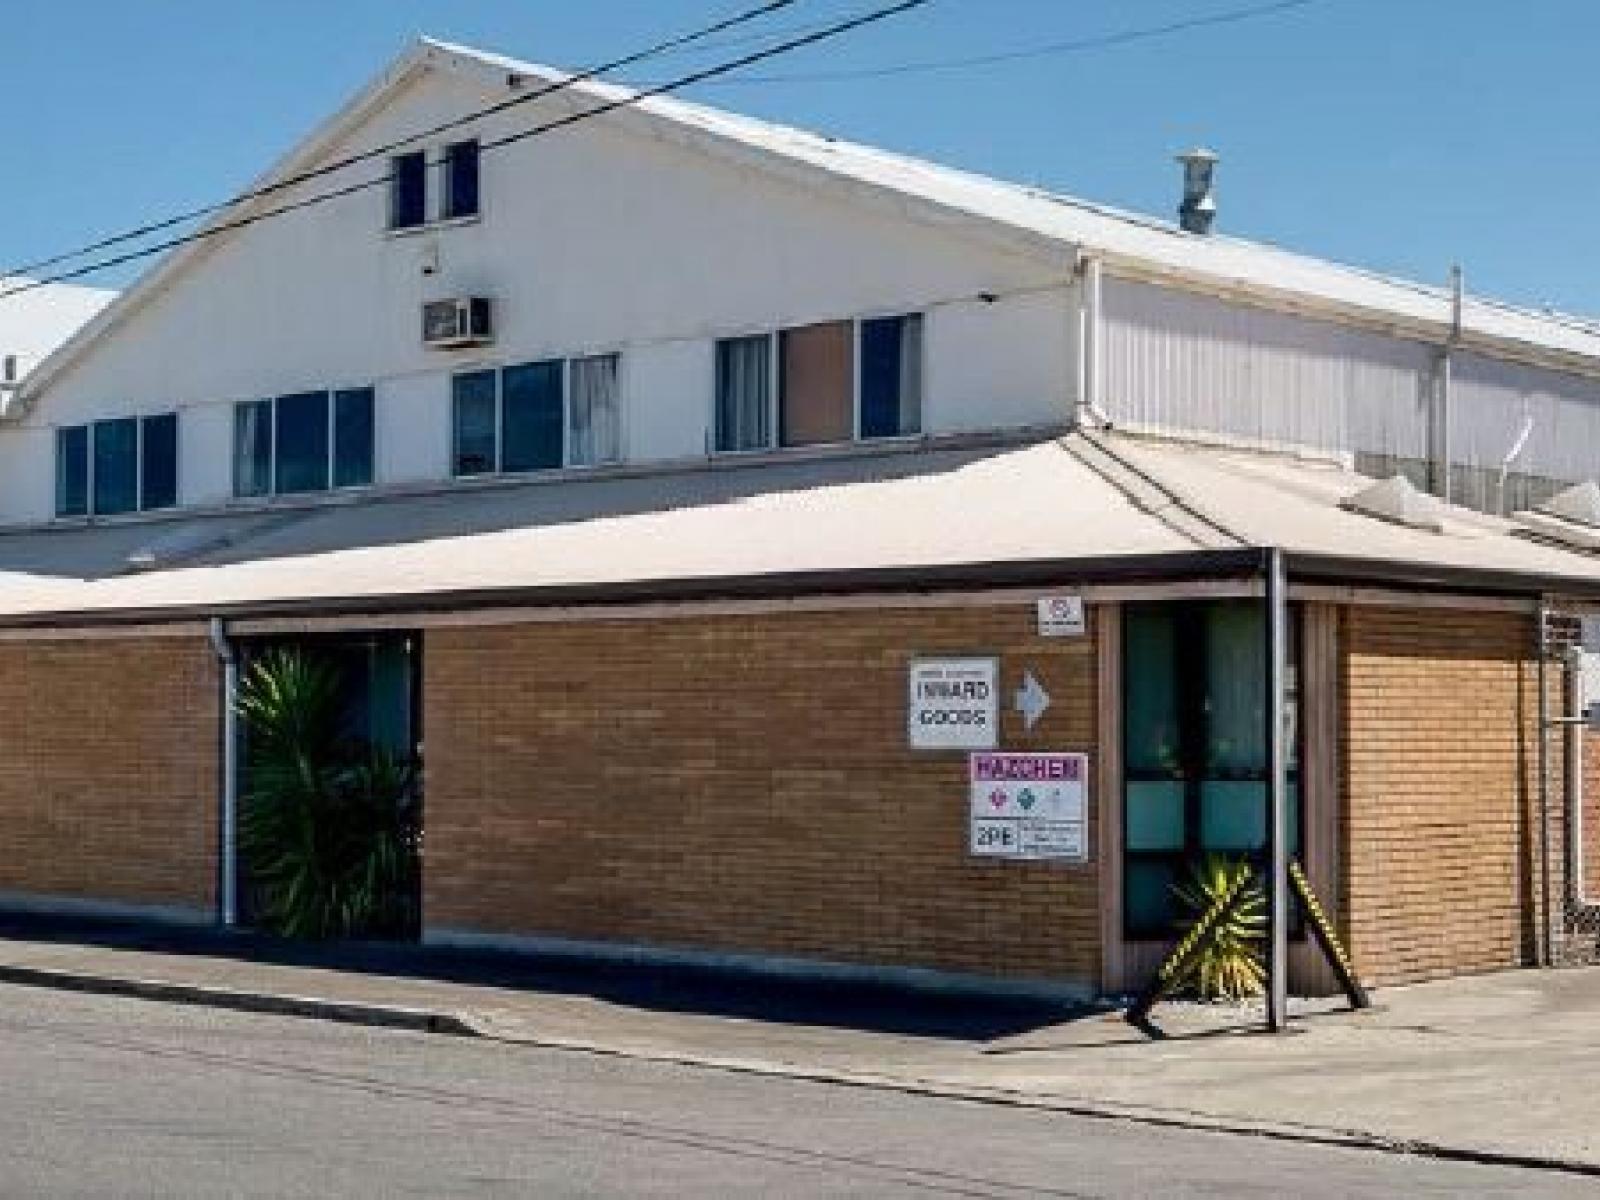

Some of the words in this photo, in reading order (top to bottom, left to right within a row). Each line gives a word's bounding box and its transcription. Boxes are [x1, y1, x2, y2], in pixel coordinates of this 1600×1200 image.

[917, 682, 989, 699] INWARD
[921, 710, 985, 724] GOODS
[977, 759, 1078, 777] HAZCHEM
